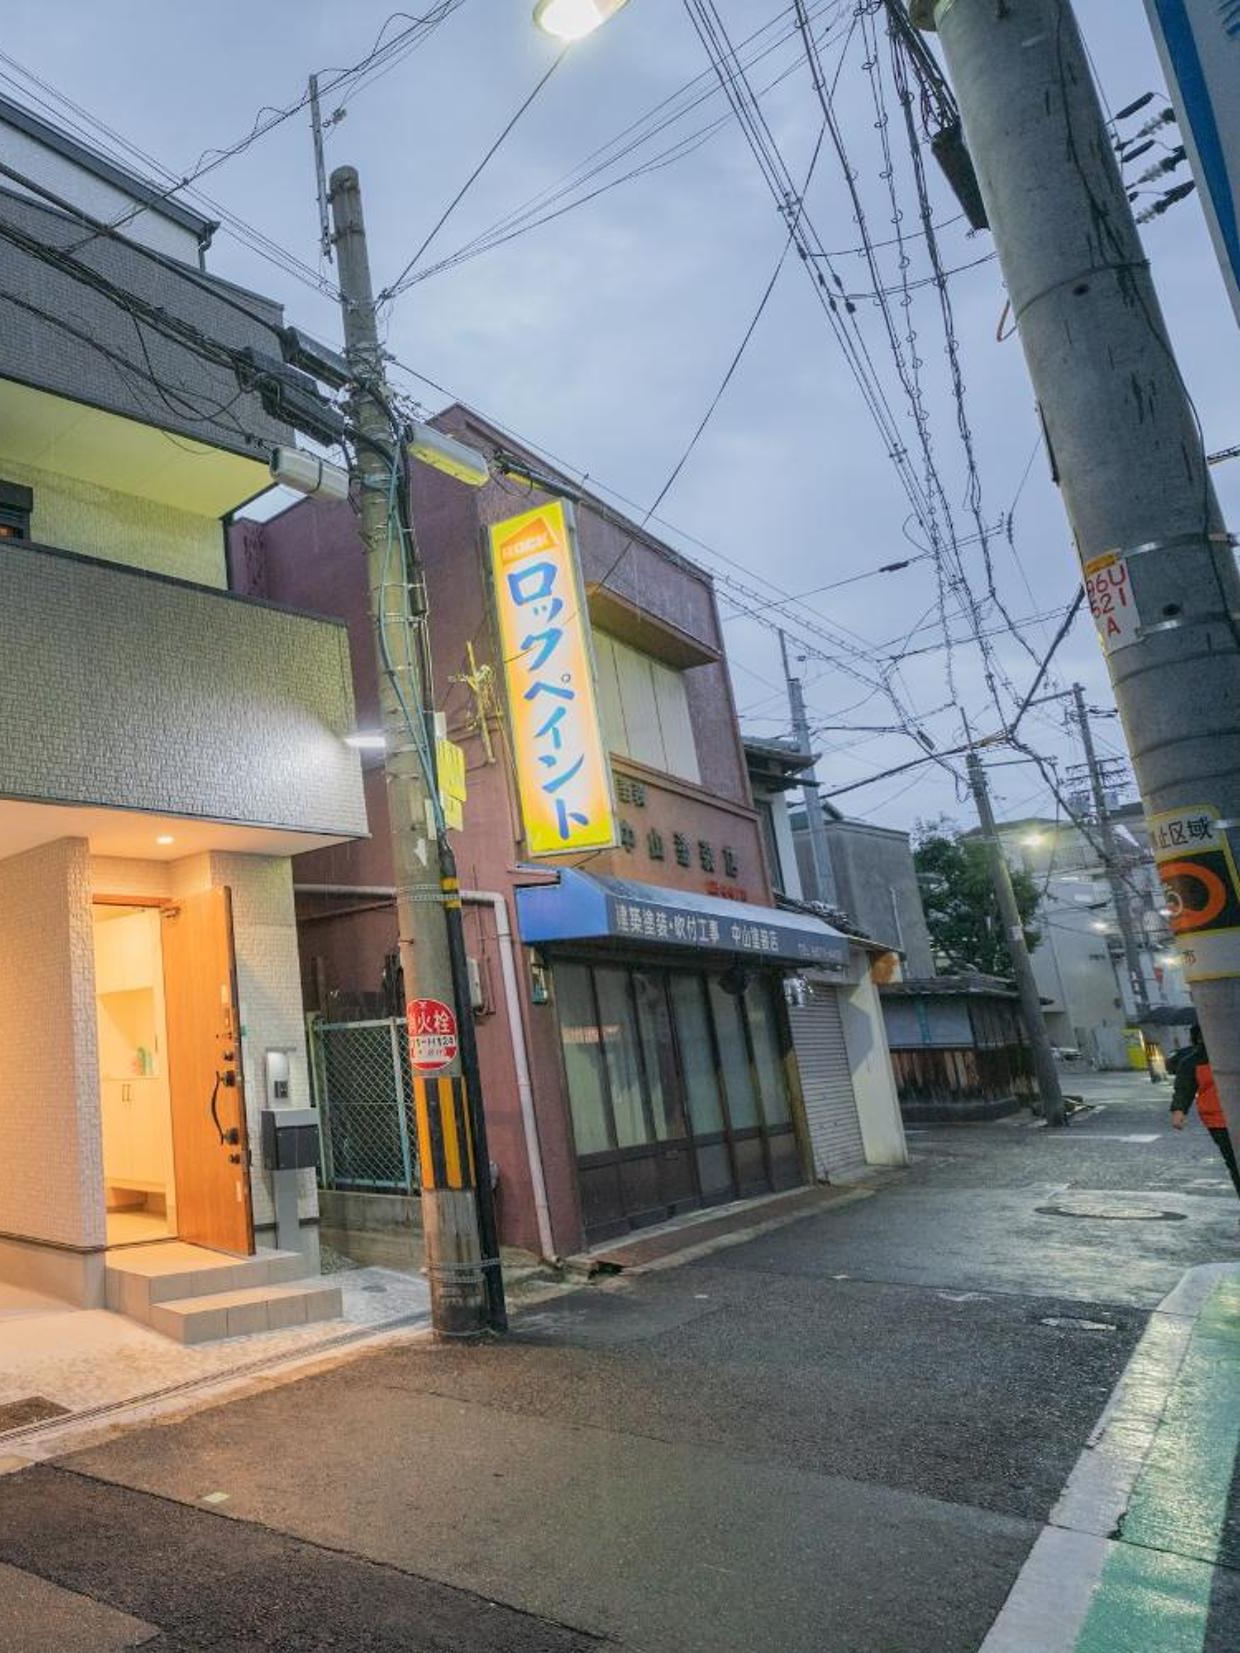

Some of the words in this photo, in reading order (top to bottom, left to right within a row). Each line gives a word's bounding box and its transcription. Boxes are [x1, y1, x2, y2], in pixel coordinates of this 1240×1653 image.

[507, 561, 589, 841] ロックペイント
[1107, 616, 1122, 637] A
